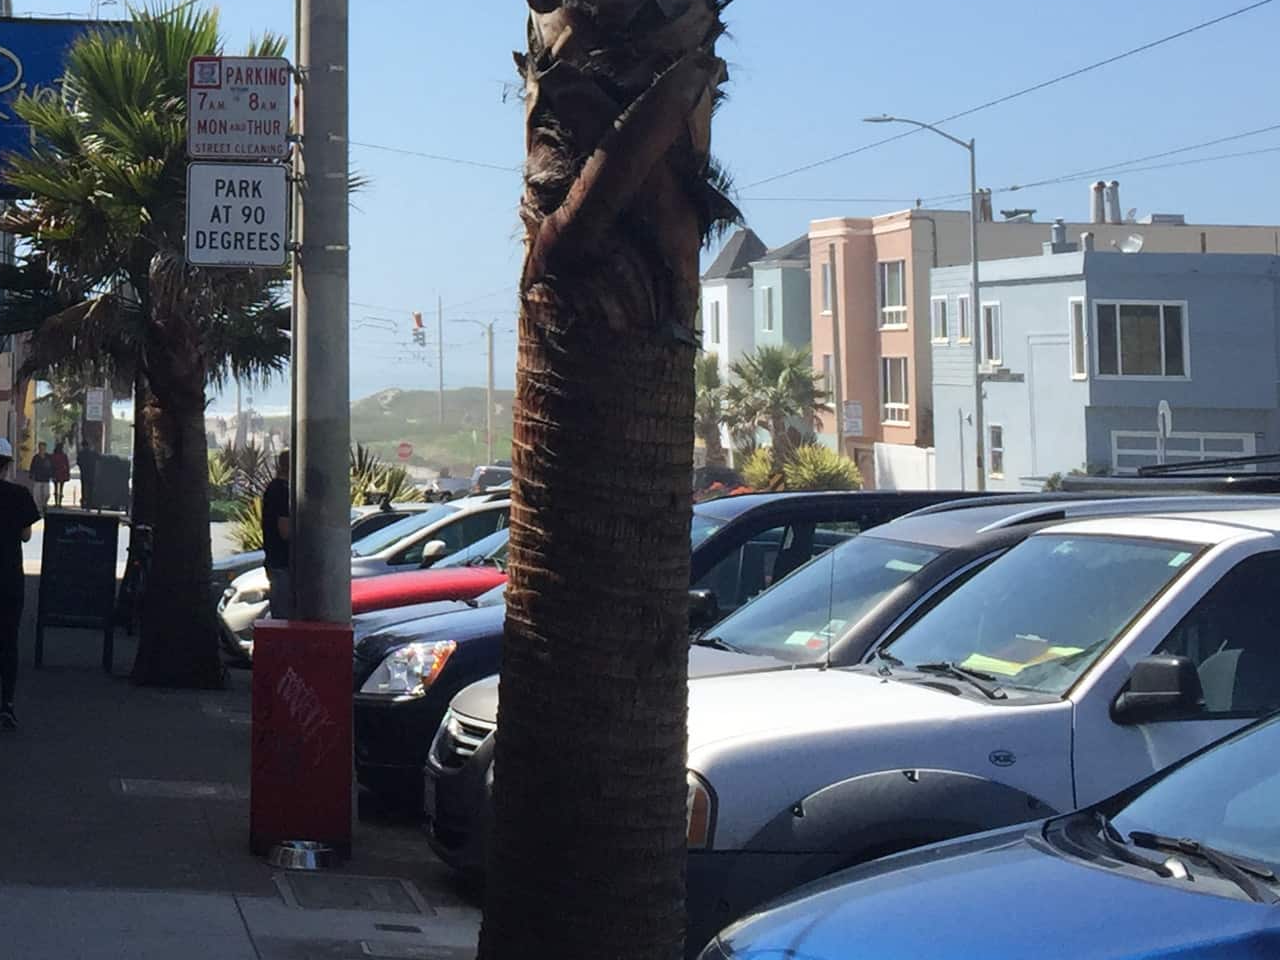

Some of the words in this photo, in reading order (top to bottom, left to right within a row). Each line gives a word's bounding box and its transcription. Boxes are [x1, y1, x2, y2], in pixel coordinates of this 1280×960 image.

[226, 66, 287, 86] PARKING
[197, 120, 227, 136] MON
[248, 120, 280, 136] THUR
[195, 144, 231, 154] STREET
[235, 144, 284, 154] CLEANING
[215, 179, 263, 199] PARK
[210, 205, 232, 224] AT
[241, 206, 265, 225] 90
[195, 231, 280, 251] DEGREES
